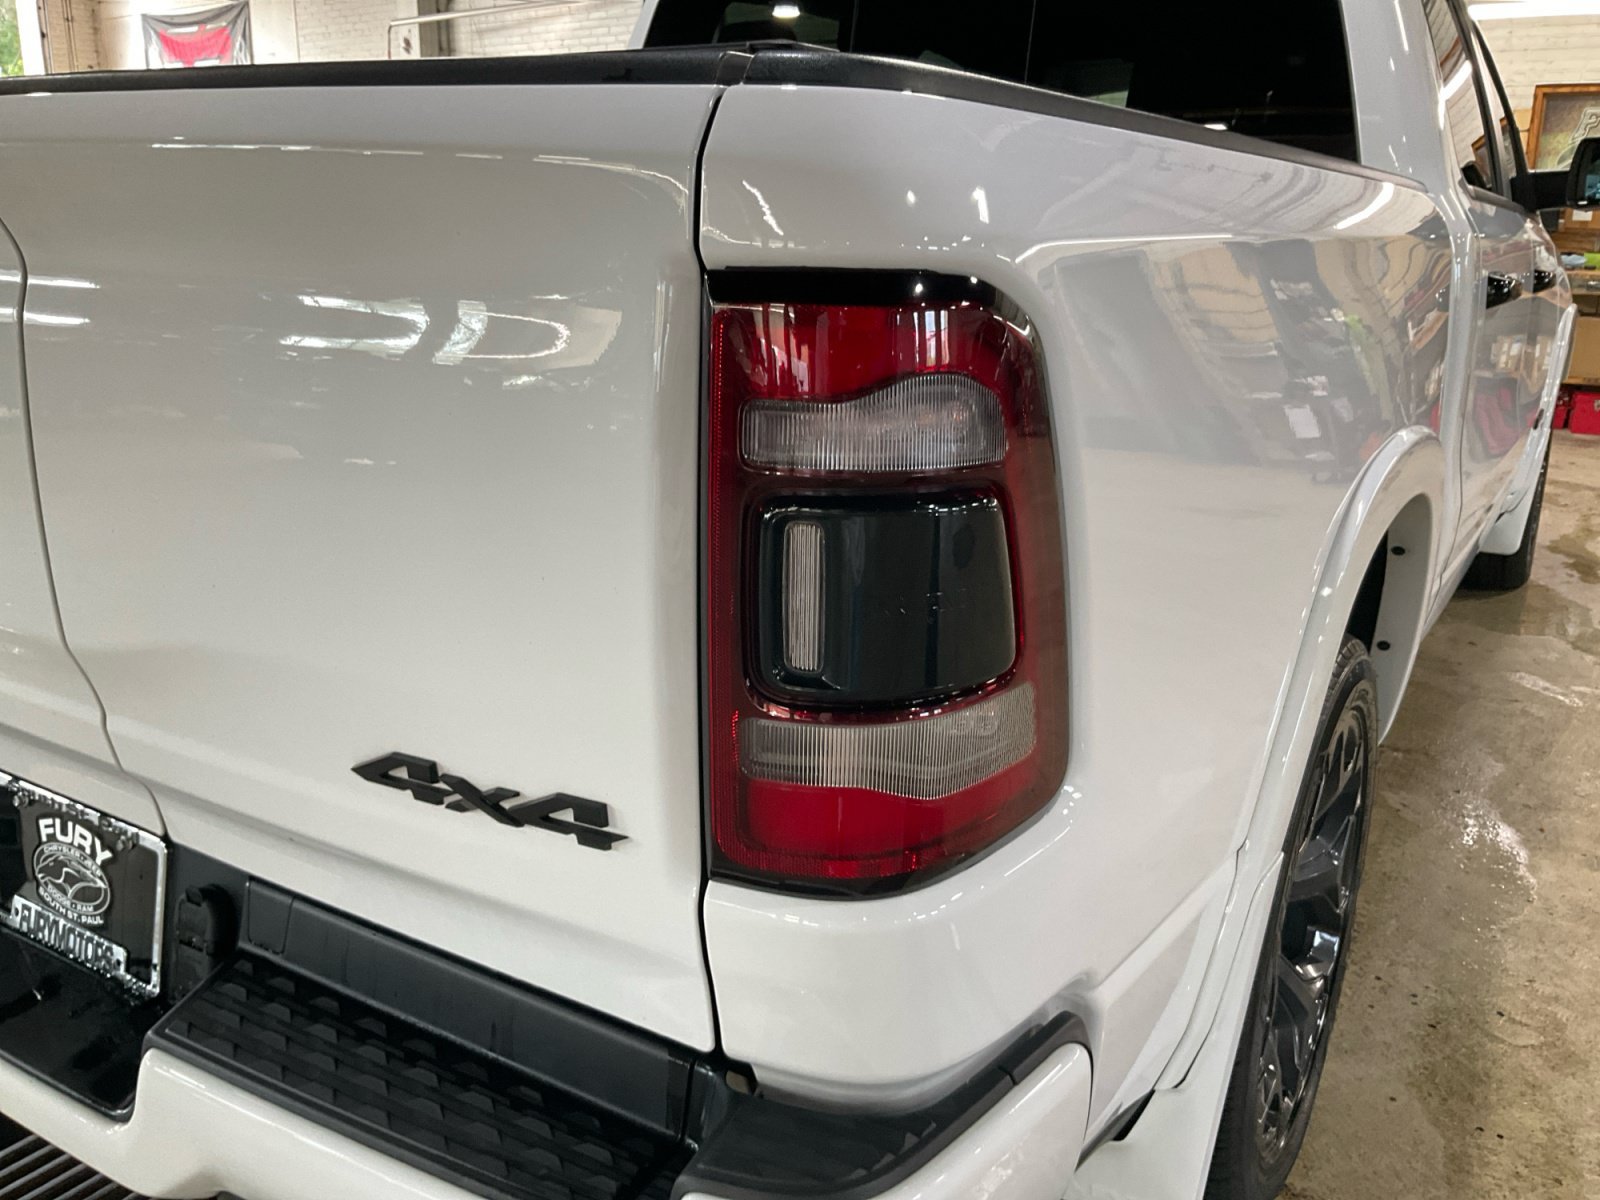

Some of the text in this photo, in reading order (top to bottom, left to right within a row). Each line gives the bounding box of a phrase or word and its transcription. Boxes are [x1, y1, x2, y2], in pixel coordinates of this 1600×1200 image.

[38, 818, 113, 866] FURY
[43, 845, 80, 859] CHRYSLER
[39, 886, 66, 915] SOUTH
[81, 914, 104, 925] PAUL
[76, 904, 94, 913] RAM
